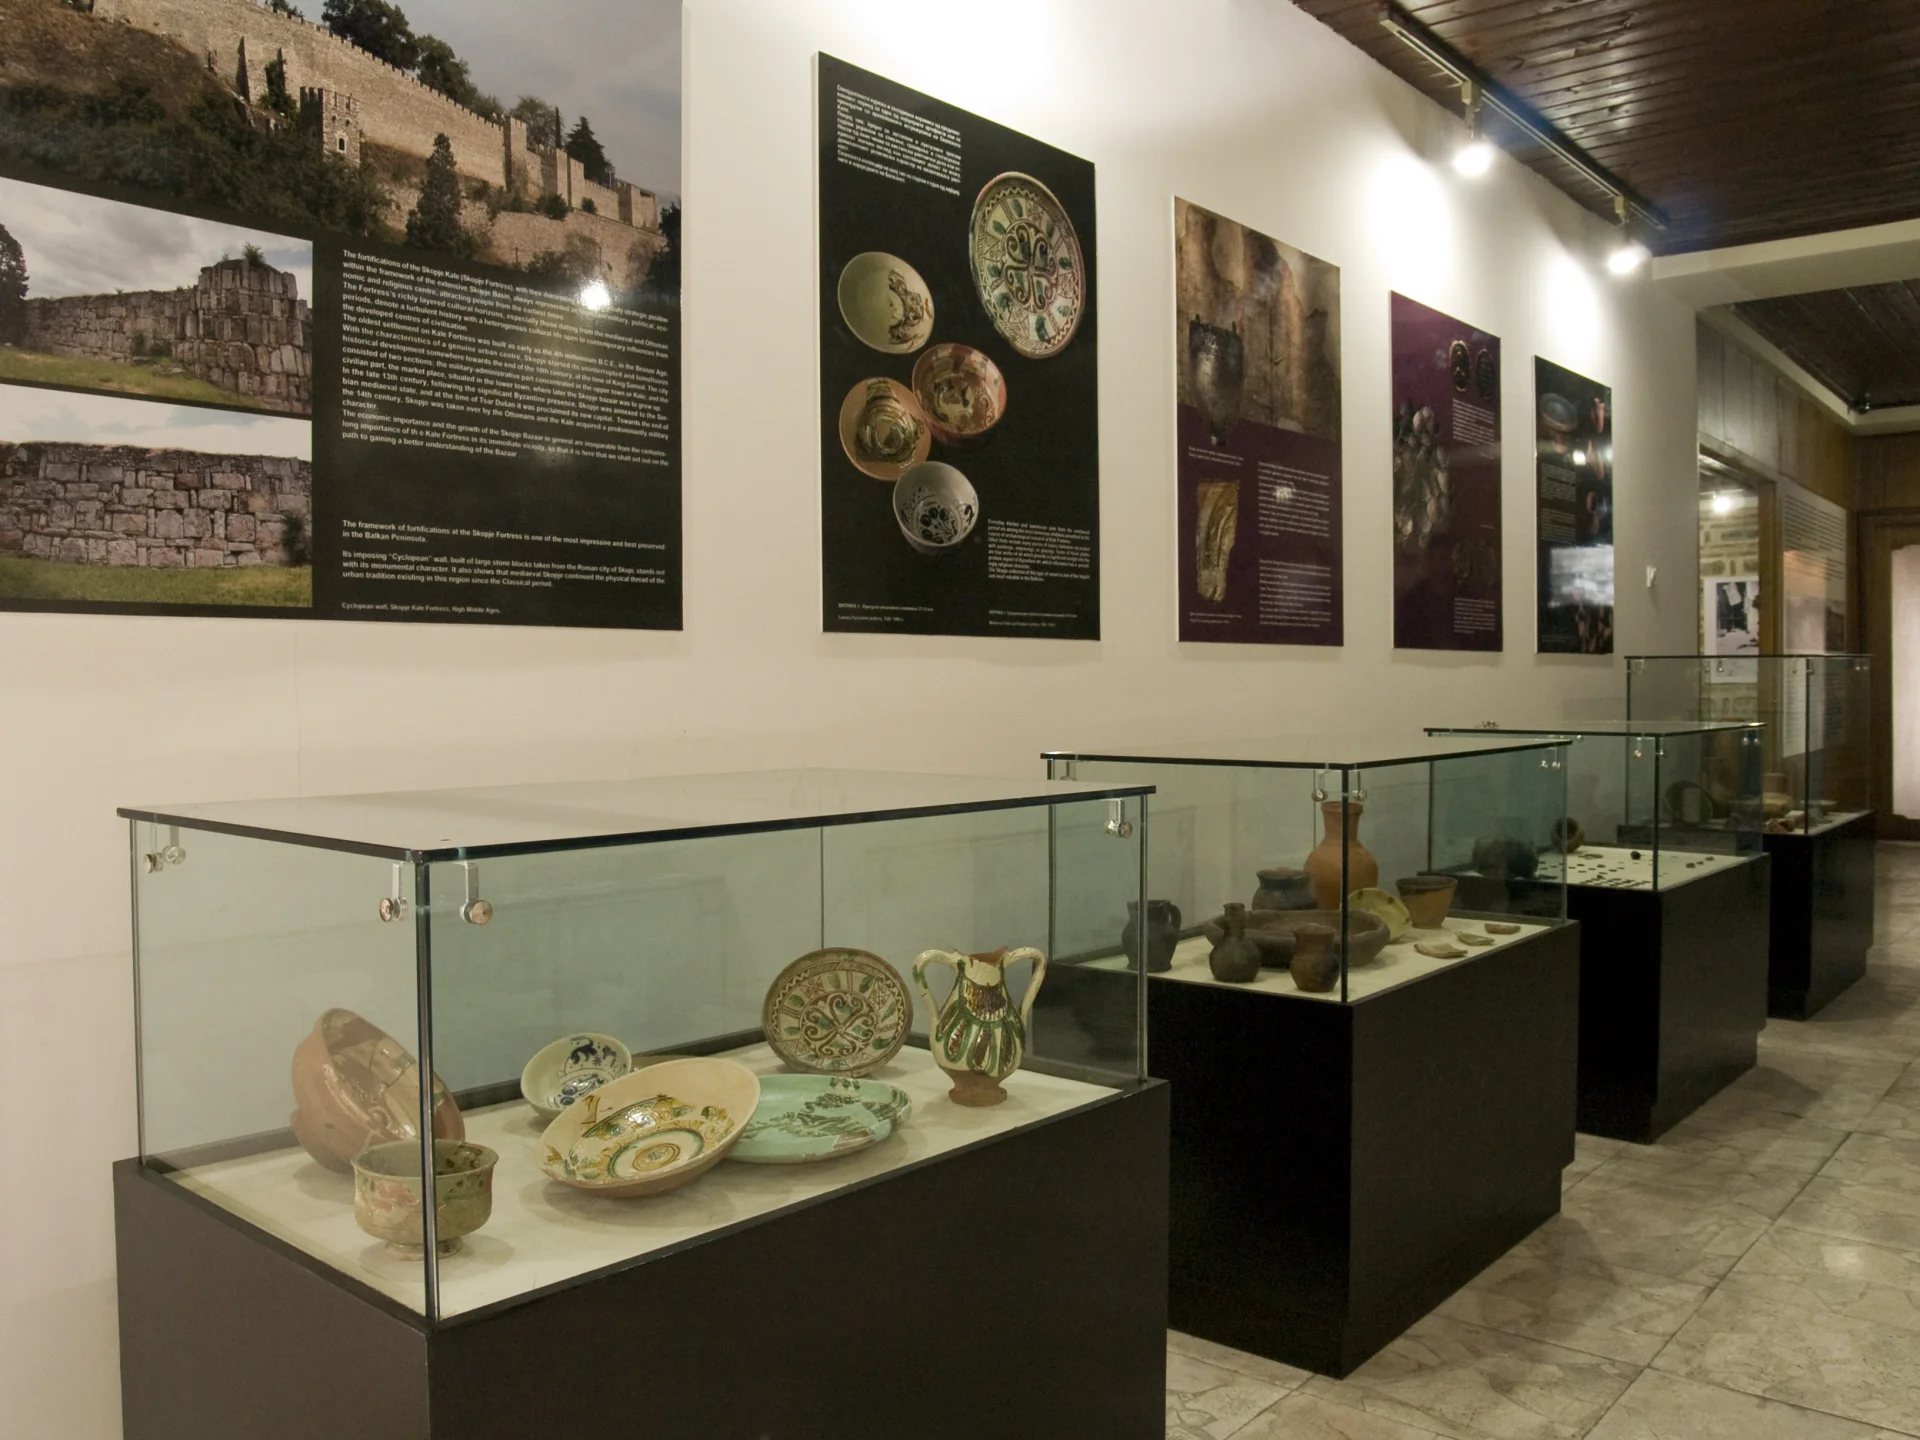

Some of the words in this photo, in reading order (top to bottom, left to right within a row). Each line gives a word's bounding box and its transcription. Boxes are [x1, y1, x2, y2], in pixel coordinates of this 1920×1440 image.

[343, 260, 364, 270] within
[366, 265, 376, 273] the
[379, 267, 414, 280] framework
[344, 249, 356, 258] The
[357, 252, 400, 267] fortifications
[422, 266, 443, 277] Skopje
[445, 270, 459, 279] Kale
[343, 270, 364, 281] nomic
[367, 275, 380, 284] and
[382, 278, 412, 292] religious
[342, 302, 354, 310] the
[356, 304, 393, 319] developed
[394, 312, 420, 322] centres
[343, 281, 356, 290] The
[604, 331, 632, 342] mediaeval
[374, 297, 398, 308] denote
[586, 337, 625, 351] contemporary
[342, 323, 359, 333] With
[361, 327, 373, 335] the
[548, 358, 570, 368] started
[343, 313, 356, 322] The
[358, 316, 380, 326] oldest
[635, 364, 654, 373] Bronze
[342, 334, 378, 346] historical
[612, 379, 625, 388] King
[342, 345, 377, 357] consisted
[388, 352, 401, 360] two
[535, 376, 574, 388] concentrated
[342, 355, 368, 366] civilian
[533, 385, 551, 394] where
[578, 392, 597, 402] Skopje
[352, 367, 363, 375] the
[366, 370, 379, 378] late
[383, 372, 397, 380] 13th
[514, 392, 544, 403] Byzantine
[546, 398, 578, 408] presence,
[578, 401, 598, 411] Skopje
[614, 407, 637, 416] annexed
[342, 376, 358, 385] bian
[361, 379, 397, 390] mediaeval
[536, 404, 569, 416] proclaimed
[342, 387, 353, 395] the
[357, 389, 371, 398] 14th
[504, 410, 534, 420] Ottomans
[576, 420, 600, 430] acquired
[342, 419, 358, 429] long
[360, 421, 400, 434] importance
[442, 432, 469, 441] Fortress
[342, 430, 358, 439] path
[369, 433, 395, 444] gaining
[404, 437, 423, 446] better
[425, 440, 473, 453] understanding
[495, 448, 516, 456] Bazaar
[357, 410, 390, 421] economic
[458, 423, 479, 433] growth
[523, 432, 542, 440] Bazaar
[551, 435, 573, 445] general
[358, 521, 395, 530] framework
[407, 524, 449, 534] fortifications
[472, 529, 494, 538] Skopje
[580, 537, 610, 546] impressive
[638, 542, 664, 550] preserved
[365, 531, 389, 539] Balkan
[353, 550, 386, 560] imposing
[474, 558, 490, 566] large
[371, 562, 414, 570] monumental
[542, 571, 563, 579] Skopje
[397, 572, 424, 581] existing
[448, 575, 469, 583] region
